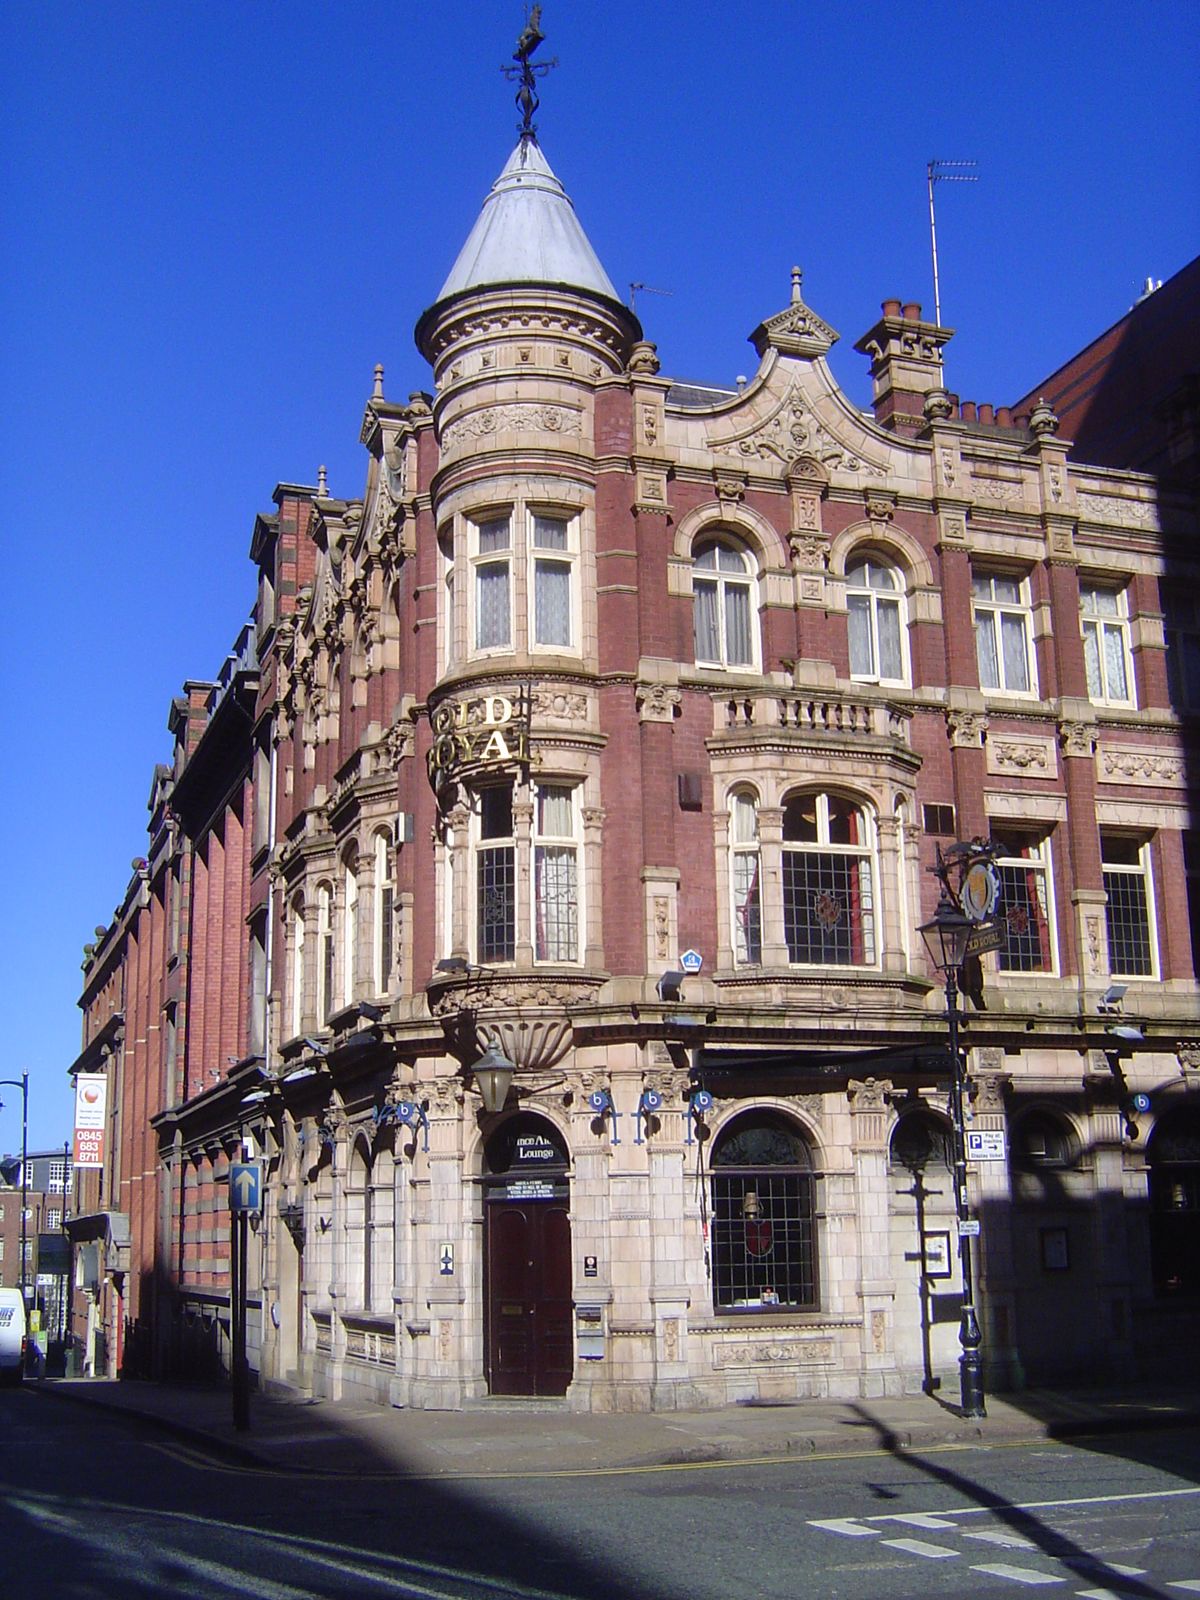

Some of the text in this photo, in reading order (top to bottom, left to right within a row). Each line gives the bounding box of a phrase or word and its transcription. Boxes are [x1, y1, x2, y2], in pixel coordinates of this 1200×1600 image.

[431, 697, 513, 734] OLD
[77, 1131, 102, 1140] 0845
[80, 1141, 98, 1151] 683
[971, 1135, 981, 1148] P
[79, 1152, 98, 1162] 8711
[519, 1147, 554, 1159] Lounge
